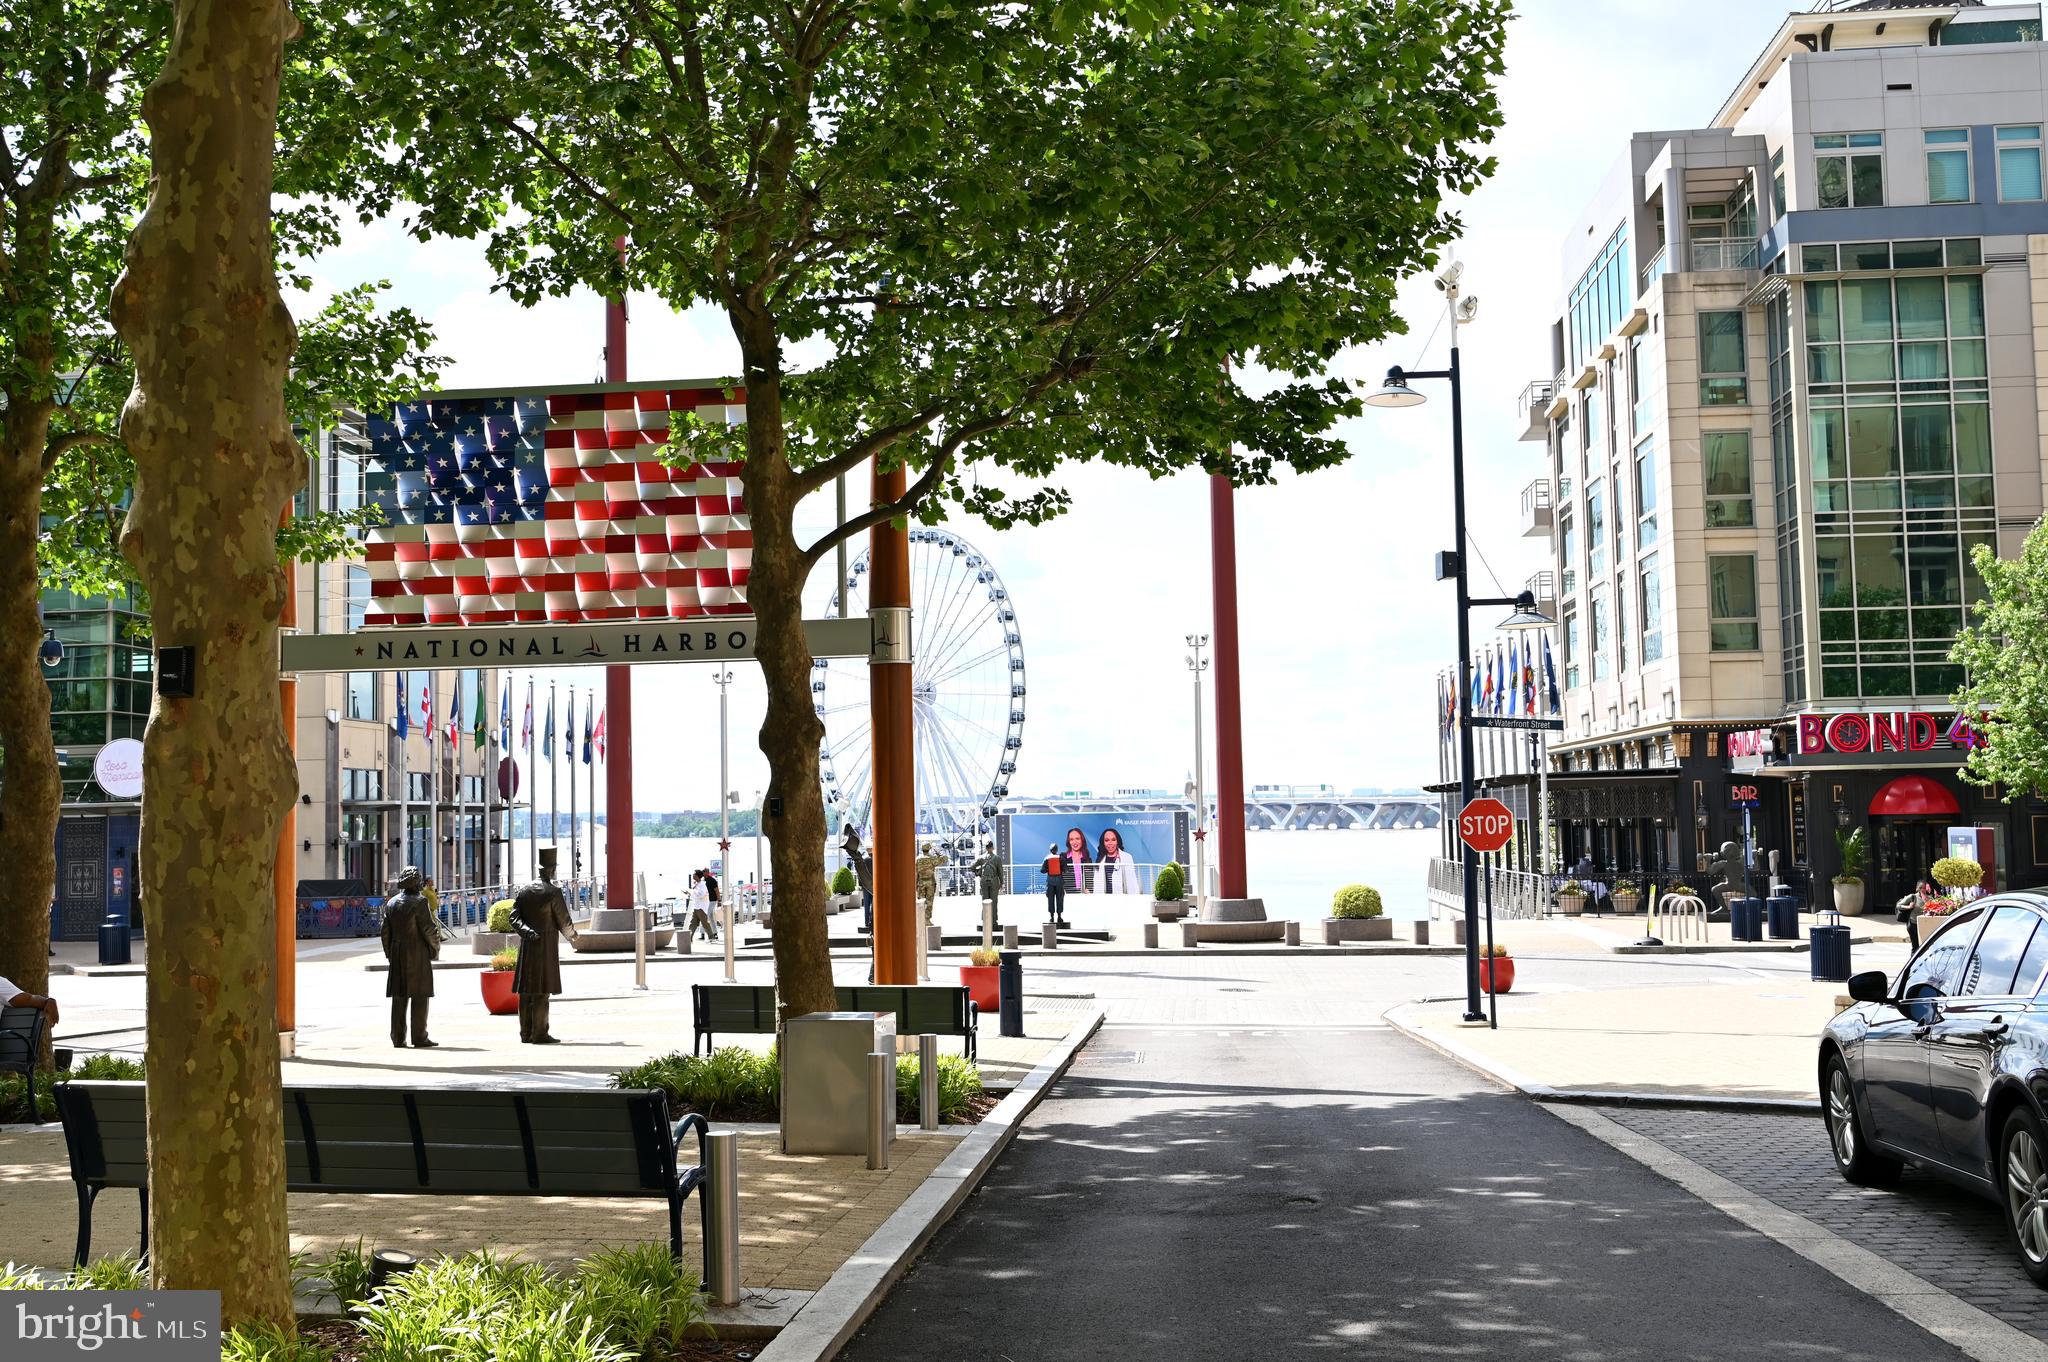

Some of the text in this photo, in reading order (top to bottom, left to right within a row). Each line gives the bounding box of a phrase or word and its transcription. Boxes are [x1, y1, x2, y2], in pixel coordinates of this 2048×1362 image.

[376, 631, 748, 661] NATIONAL HARBO
[1494, 719, 1551, 730] Waterfront Street
[1796, 712, 1938, 754] BOND
[100, 760, 128, 772] Rosa
[1731, 785, 1759, 801] BAR
[1462, 815, 1510, 836] STOP
